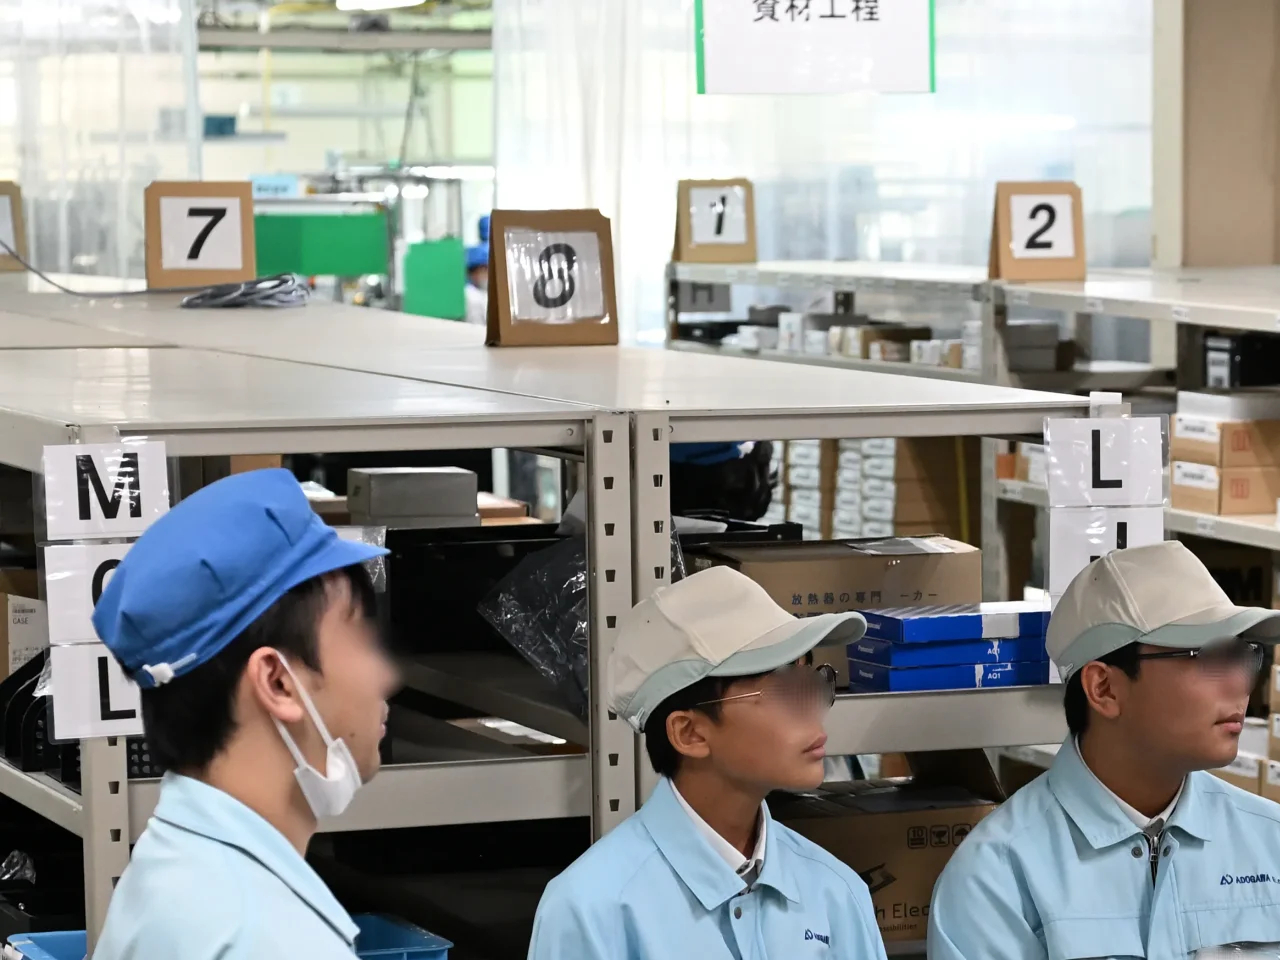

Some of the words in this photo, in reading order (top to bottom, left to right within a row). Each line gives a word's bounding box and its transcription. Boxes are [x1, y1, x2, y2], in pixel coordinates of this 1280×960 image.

[186, 207, 227, 260] 7
[1024, 203, 1057, 249] 2
[532, 243, 576, 309] 8
[75, 452, 142, 521] M
[1091, 429, 1123, 489] L
[12, 616, 29, 625] CASE
[791, 589, 938, 606] 放熱器の専門ーカー
[98, 656, 137, 721] L
